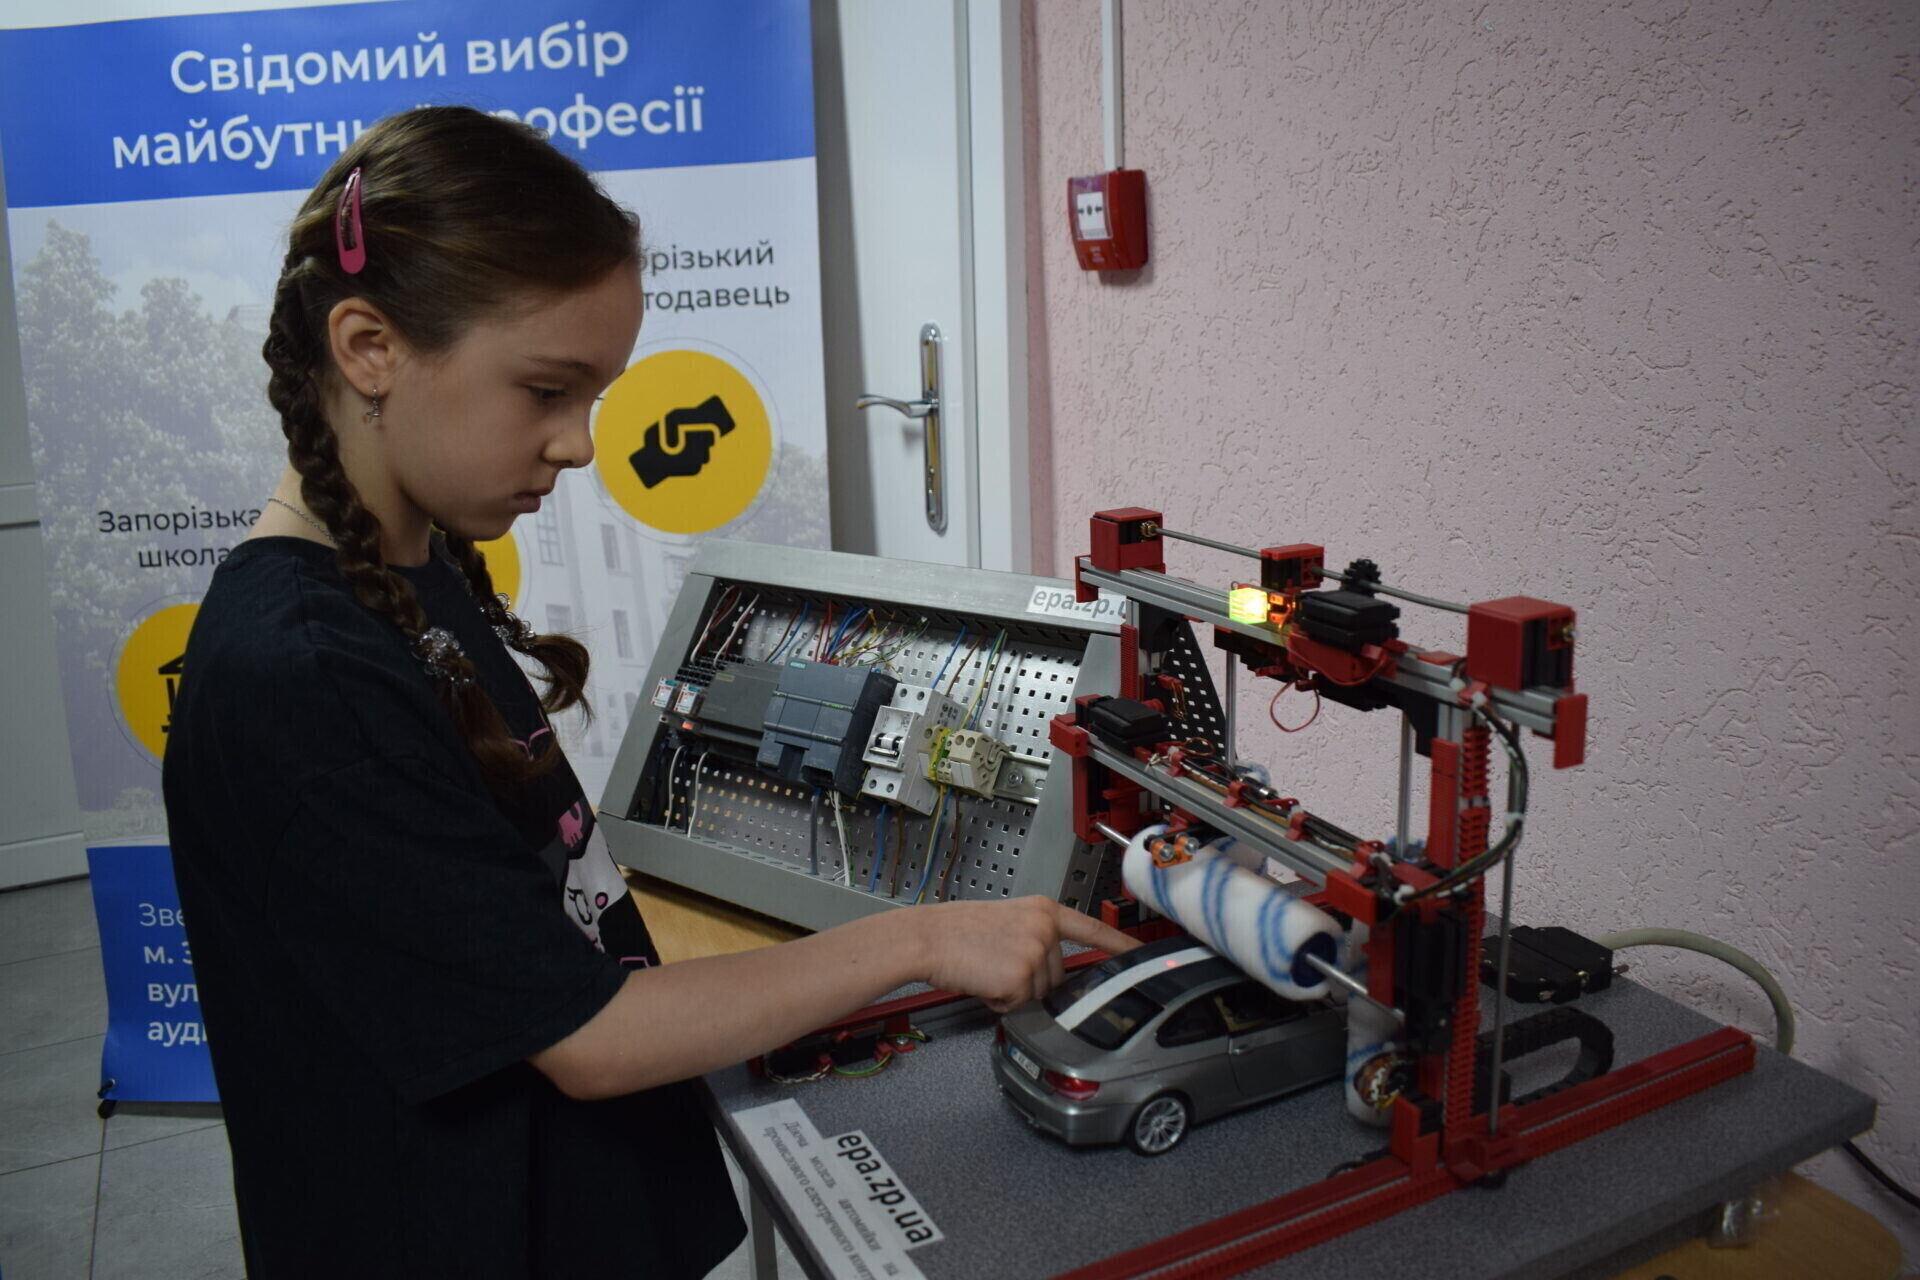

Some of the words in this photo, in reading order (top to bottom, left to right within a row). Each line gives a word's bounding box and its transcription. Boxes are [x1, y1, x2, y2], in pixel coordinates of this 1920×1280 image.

[171, 31, 446, 94] Свідомий
[467, 20, 628, 77] вибір
[113, 105, 431, 170] майбутн
[488, 86, 704, 149] офесії
[639, 239, 774, 276] різький
[643, 285, 790, 312] тодавець
[837, 1134, 933, 1243] epa.zp.ua
